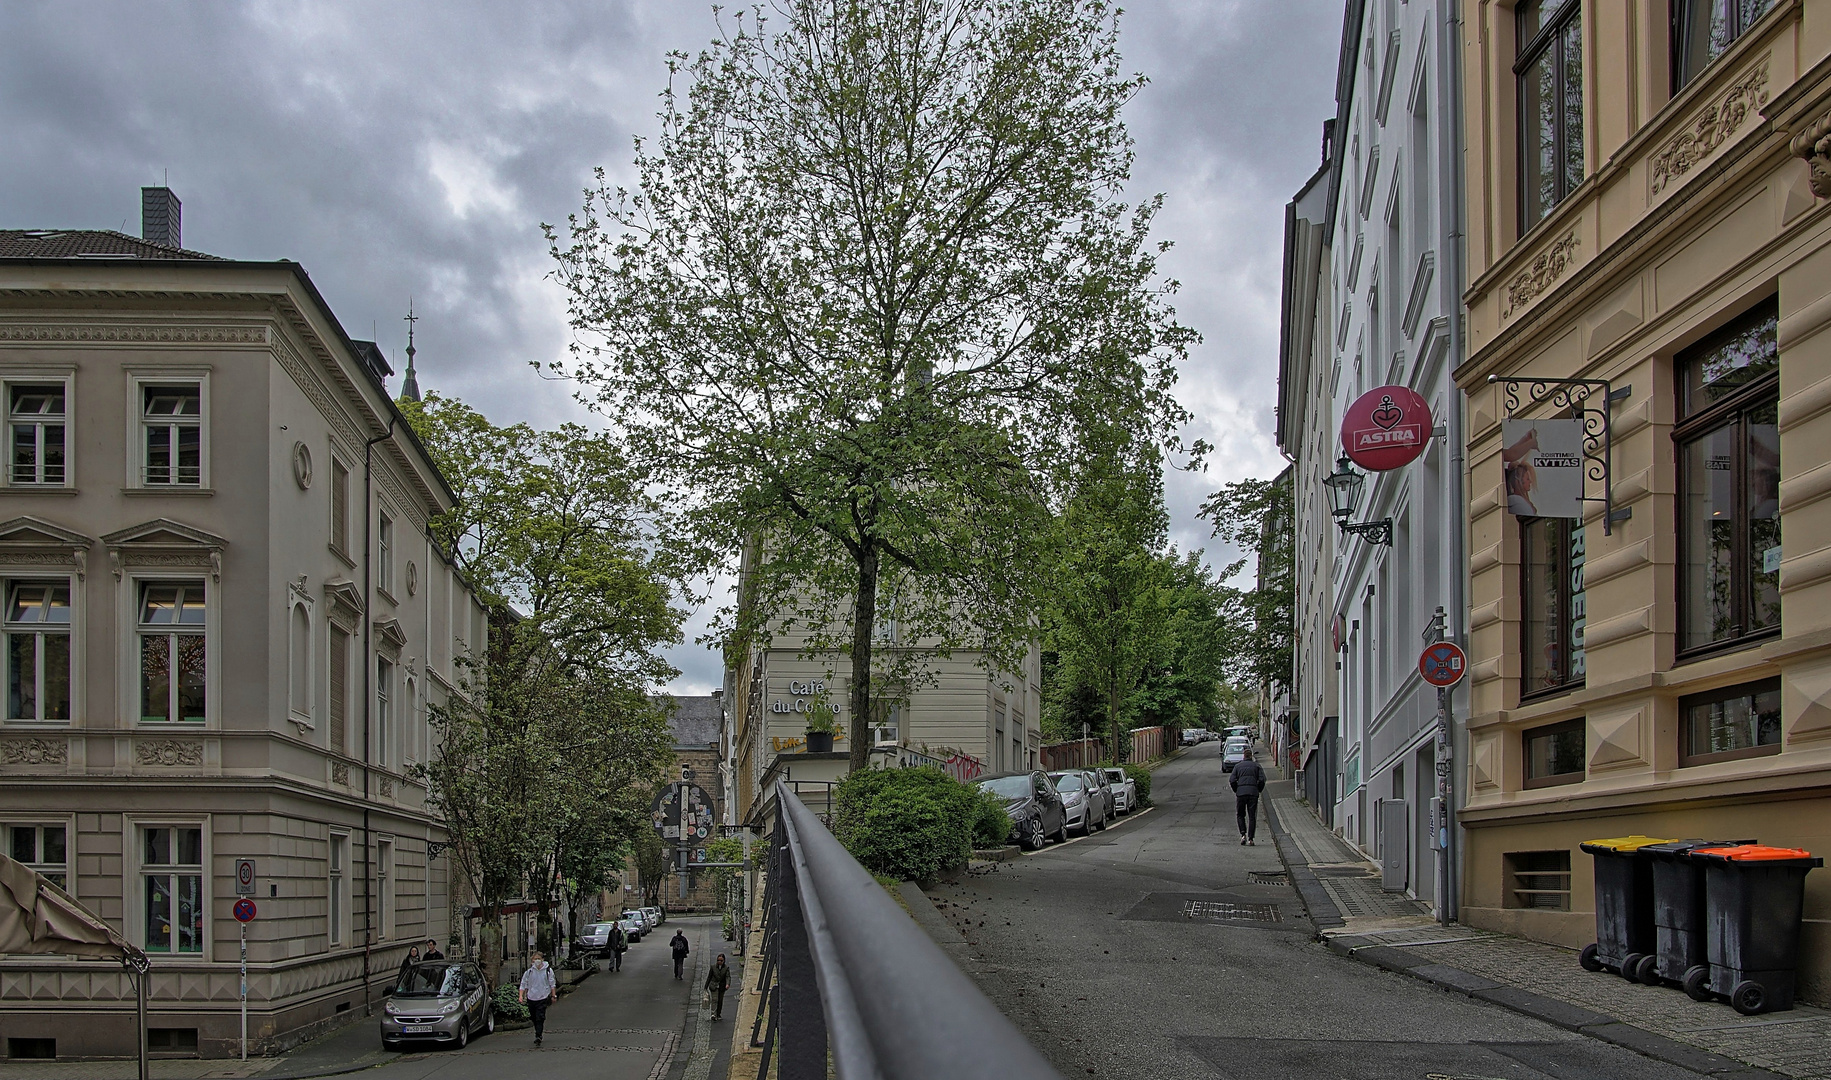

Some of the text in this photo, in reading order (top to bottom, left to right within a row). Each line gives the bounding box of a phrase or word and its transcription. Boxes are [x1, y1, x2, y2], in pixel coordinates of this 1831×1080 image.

[1359, 429, 1415, 446] ASTRA
[1535, 458, 1579, 467] KYTTAS
[1571, 518, 1587, 677] RISEUR
[790, 679, 826, 695] Café
[773, 699, 791, 713] du
[242, 868, 250, 879] 30
